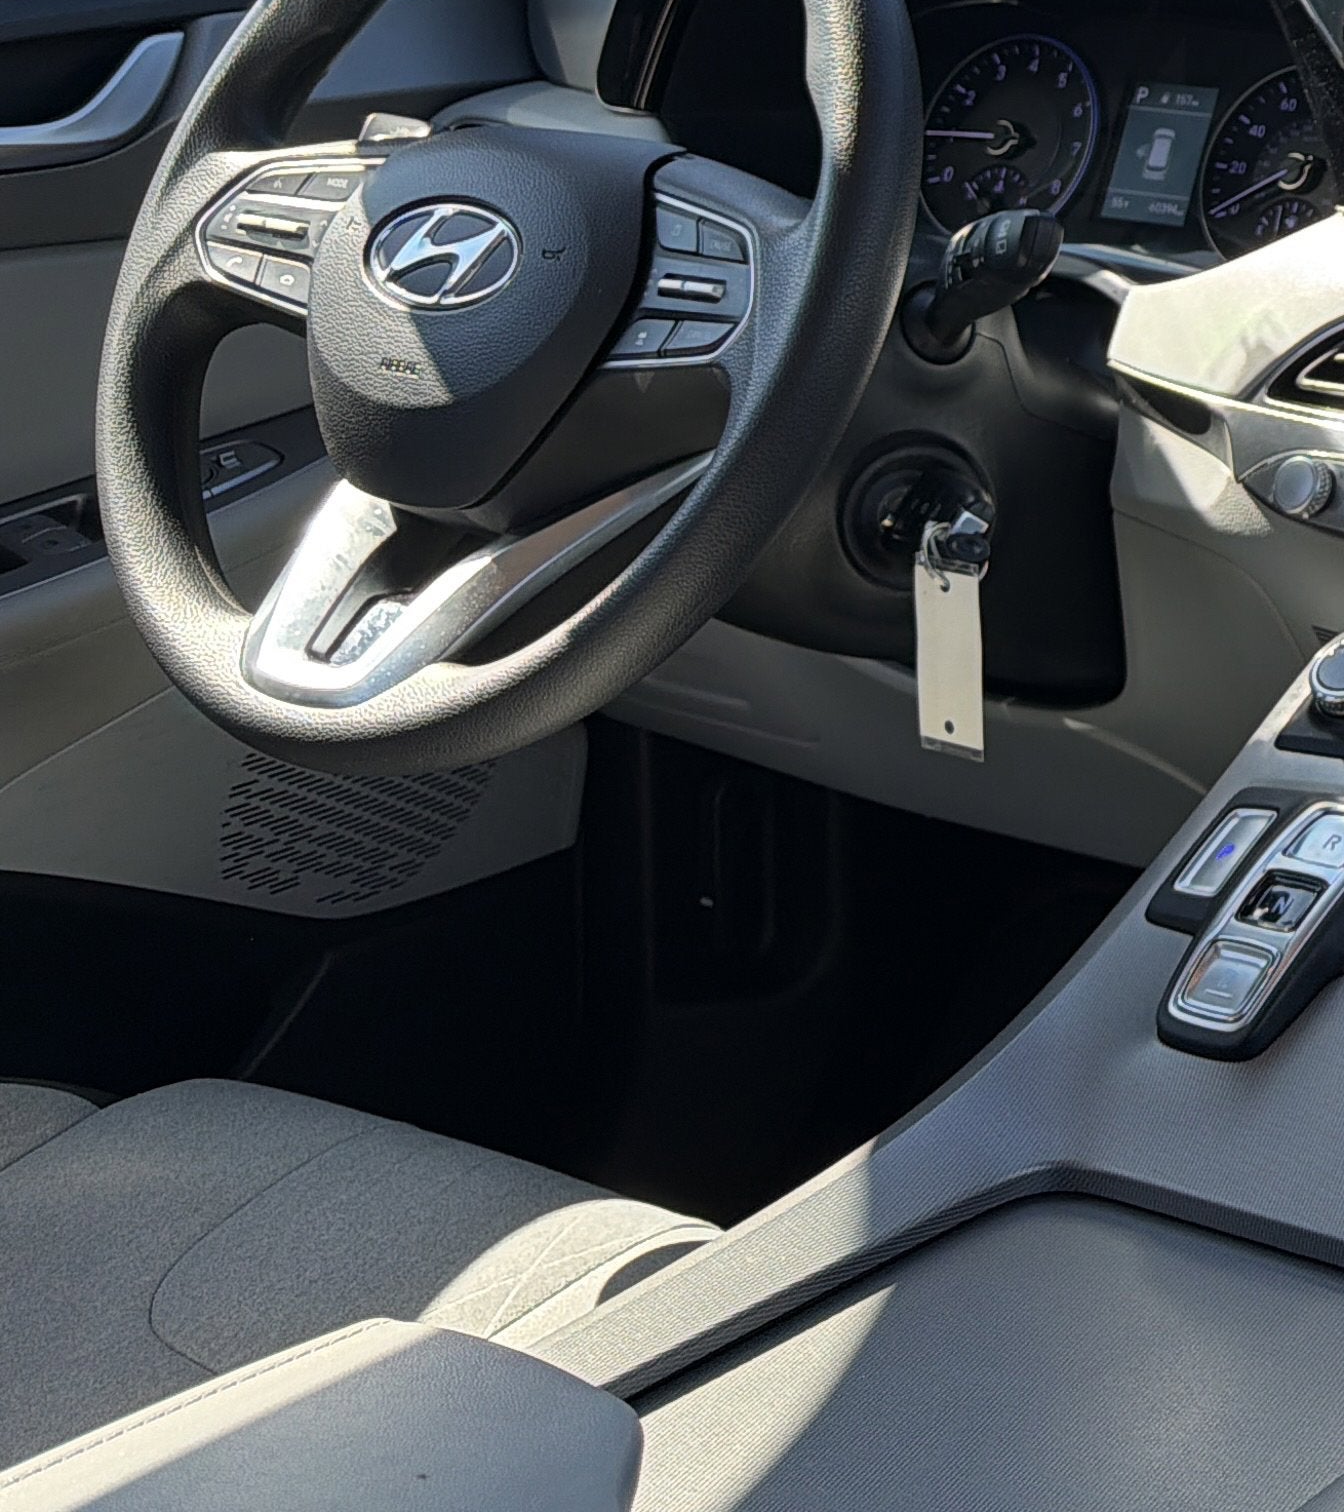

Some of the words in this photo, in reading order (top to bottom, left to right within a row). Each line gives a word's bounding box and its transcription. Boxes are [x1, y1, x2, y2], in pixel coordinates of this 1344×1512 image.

[1027, 59, 1040, 73] 4
[1057, 71, 1068, 88] 5
[965, 90, 976, 106] 2
[1135, 86, 1150, 105] P
[1072, 102, 1084, 118] 6
[1280, 98, 1297, 112] 60
[1249, 124, 1266, 139] 40
[1072, 141, 1083, 156] 7
[942, 165, 954, 182] 0
[1229, 160, 1247, 175] 20
[1050, 178, 1063, 195] 8
[1322, 833, 1343, 852] R
[1271, 895, 1297, 916] N
